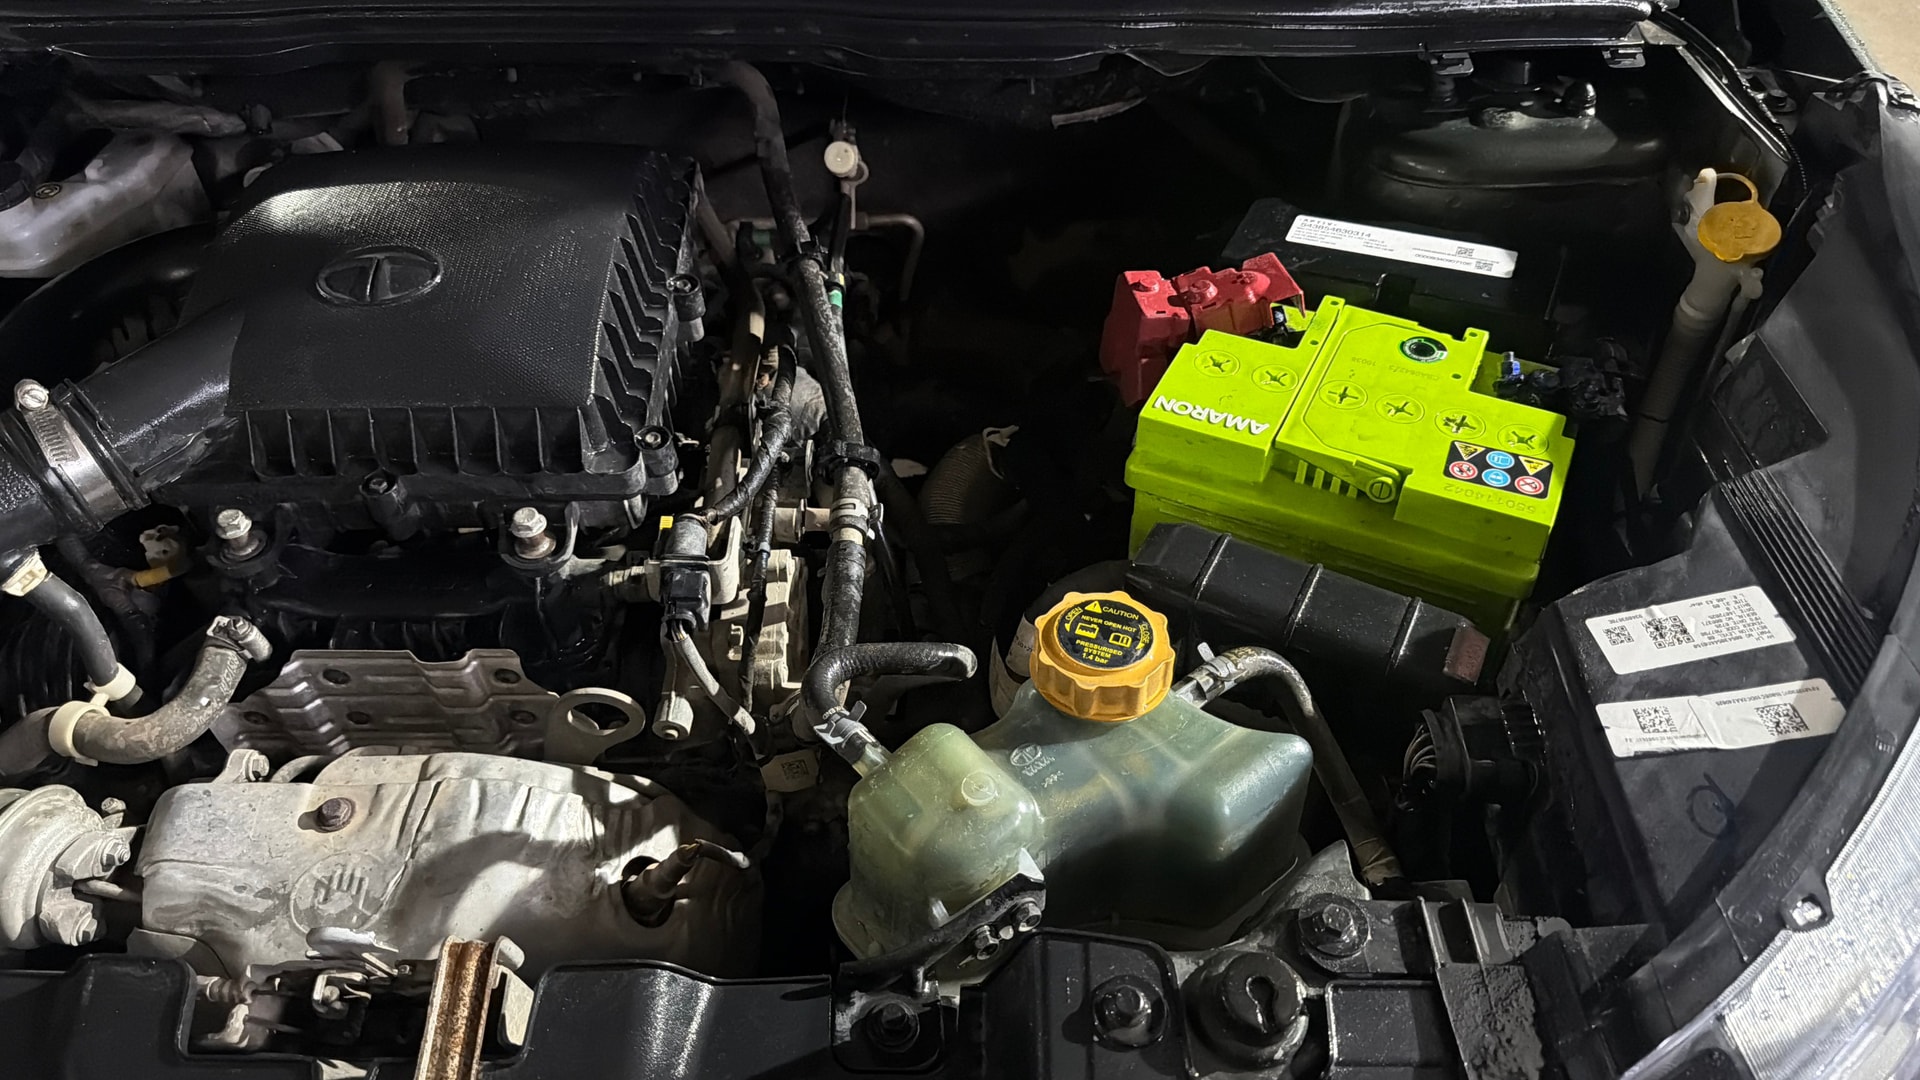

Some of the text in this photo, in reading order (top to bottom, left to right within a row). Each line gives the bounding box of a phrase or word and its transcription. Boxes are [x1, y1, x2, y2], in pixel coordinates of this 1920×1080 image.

[1152, 395, 1270, 435] AMARON
[1065, 607, 1083, 621] OPEN
[1102, 606, 1139, 620] CAUTION
[1081, 615, 1137, 633] NEVER OPEN HOT
[1076, 639, 1123, 656] PRESSURISED
[1083, 647, 1111, 659] SYSTEM
[1083, 652, 1109, 664] 1.4 bar
